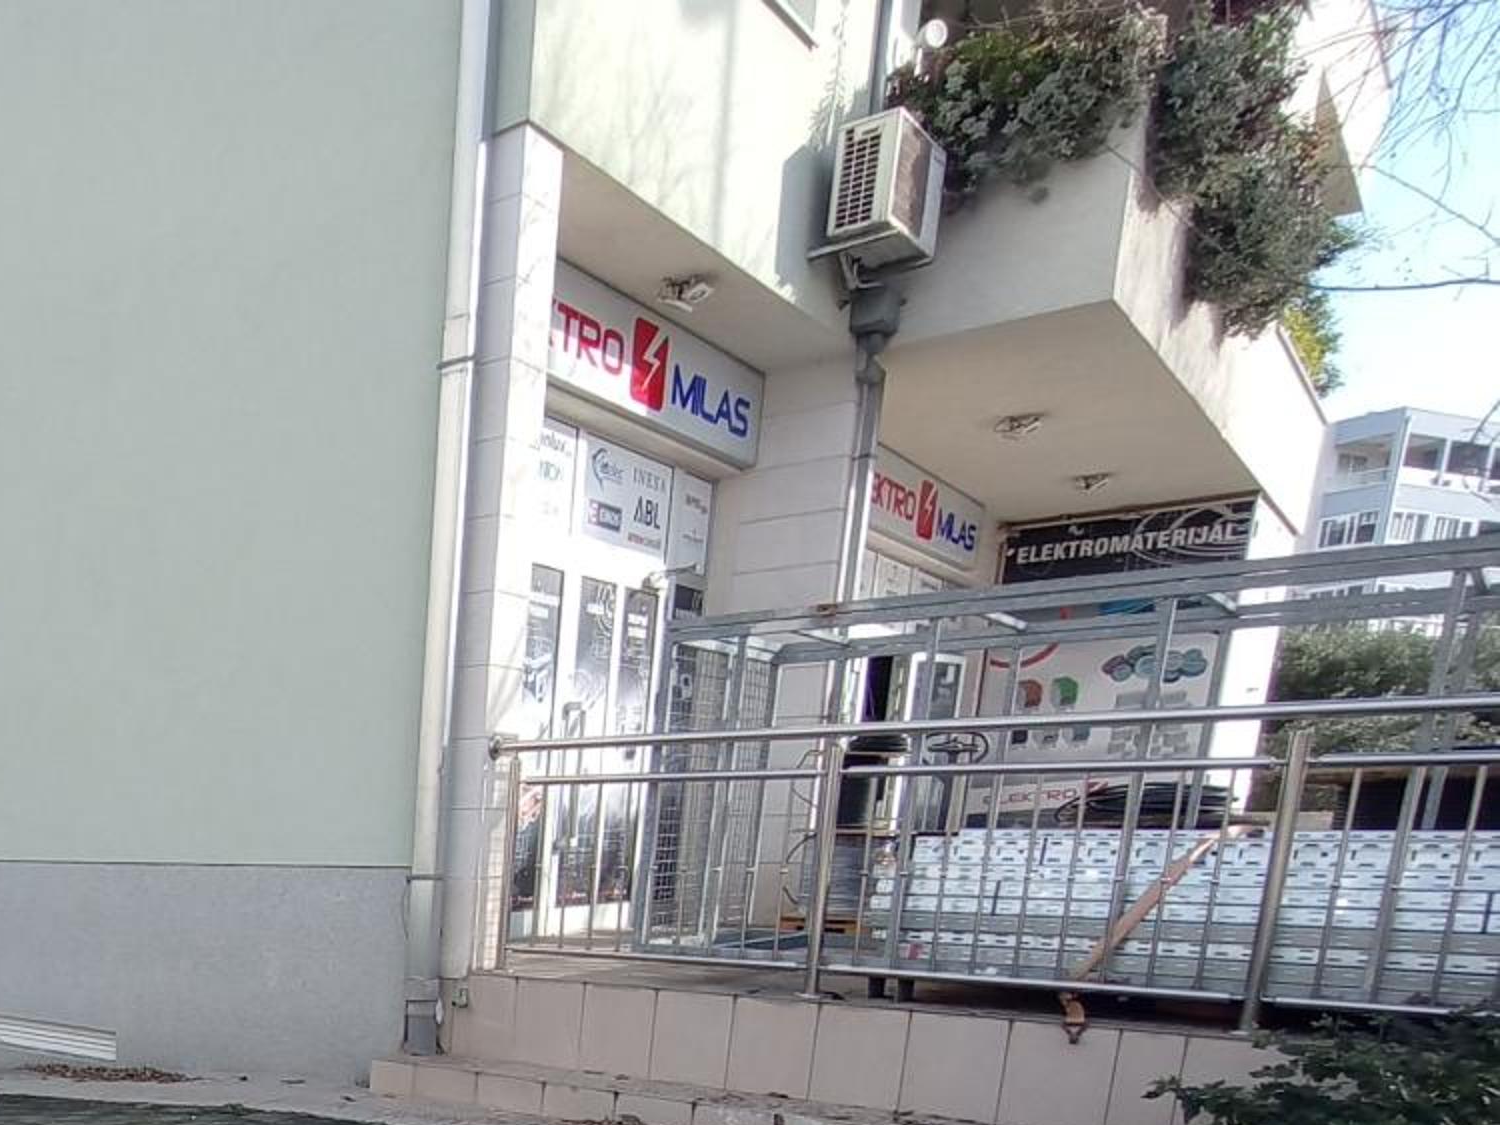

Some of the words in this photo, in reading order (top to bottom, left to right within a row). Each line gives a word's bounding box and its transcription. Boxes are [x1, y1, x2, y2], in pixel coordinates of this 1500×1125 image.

[550, 300, 624, 376] TRO
[671, 364, 750, 437] MILAS
[633, 496, 660, 529] ABL
[936, 509, 976, 551] MILAS
[1016, 524, 1239, 565] ELEKTROMATERIJAL
